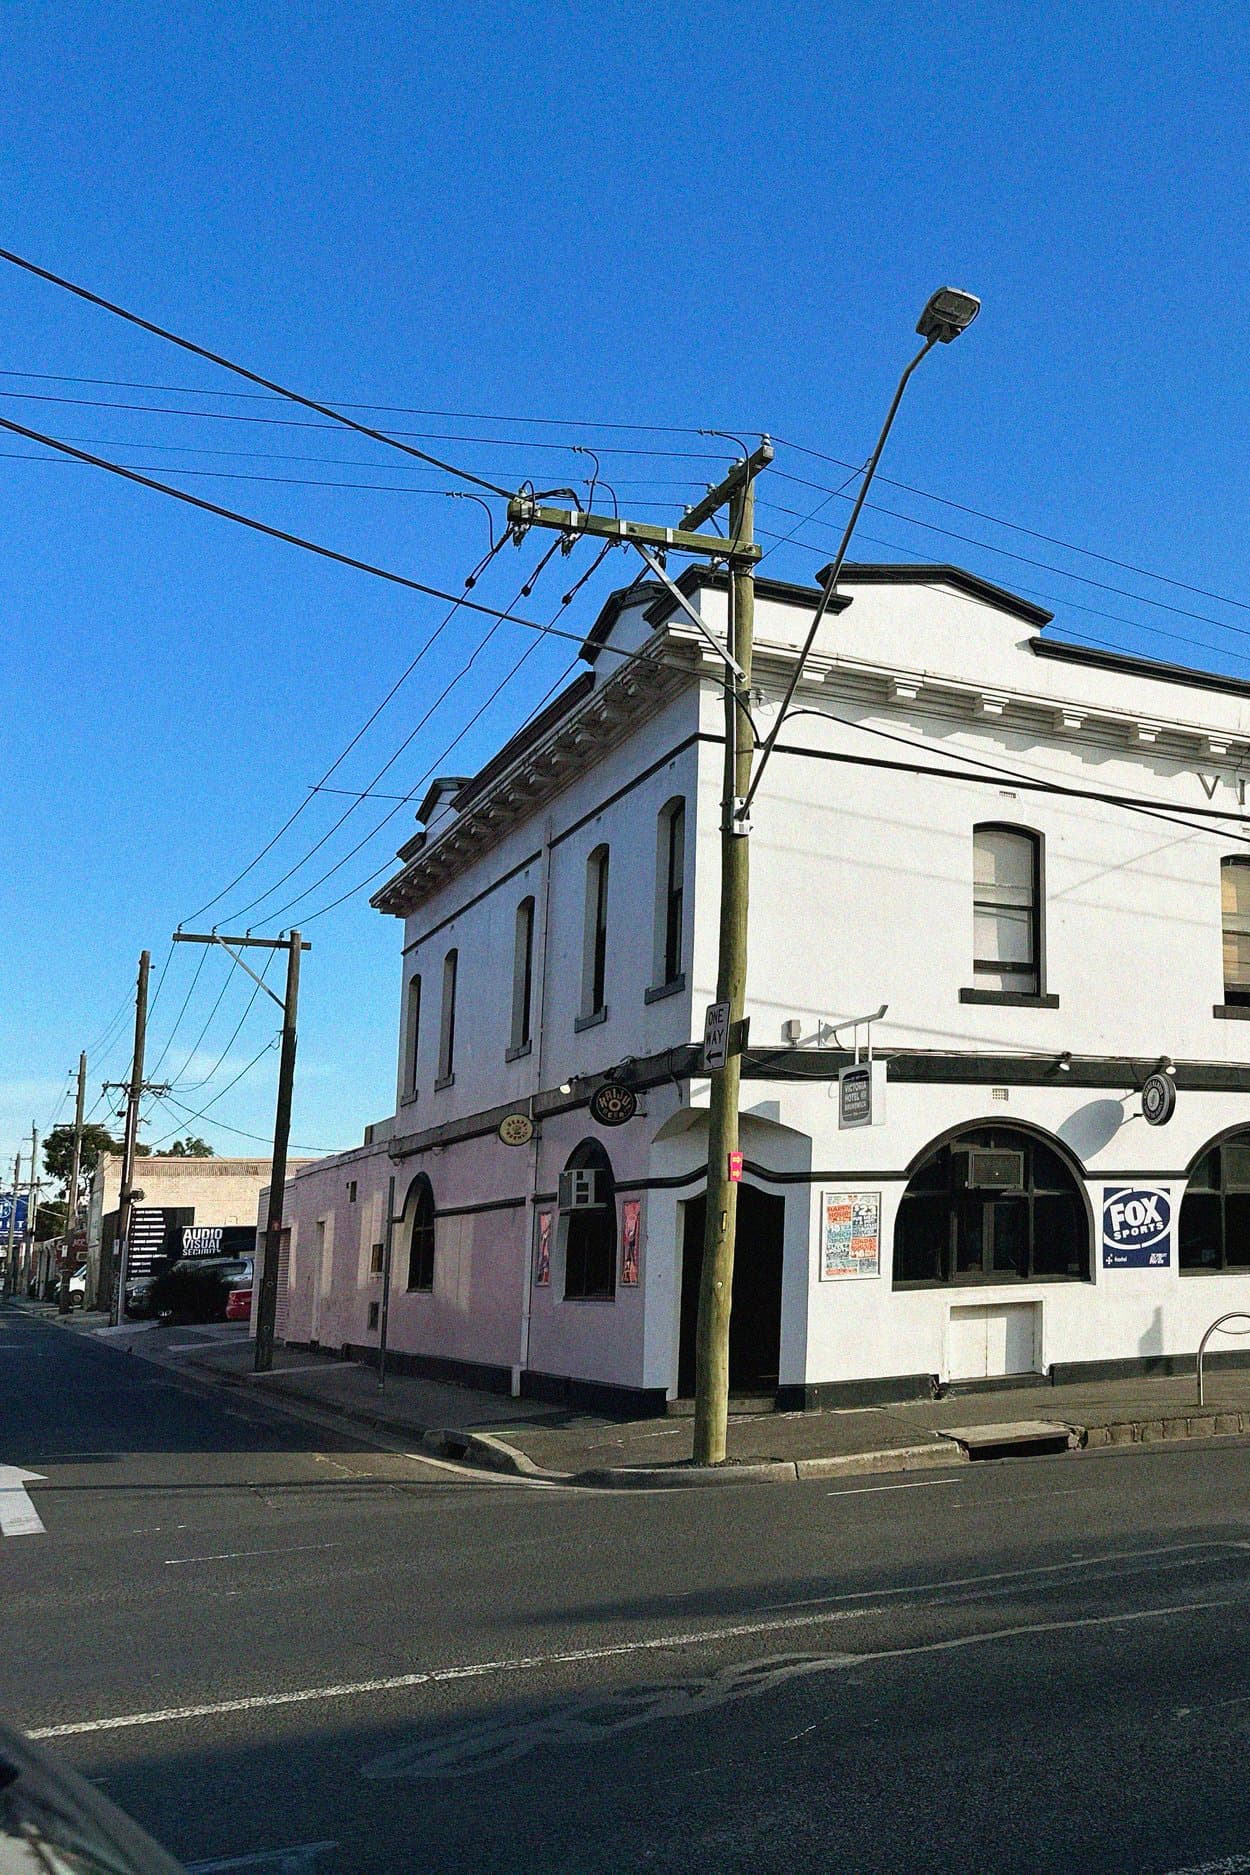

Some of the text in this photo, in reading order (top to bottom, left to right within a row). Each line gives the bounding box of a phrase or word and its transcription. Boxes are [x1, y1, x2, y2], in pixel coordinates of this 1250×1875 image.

[708, 1008, 724, 1026] ONE
[705, 1029, 724, 1046] WAY
[1110, 1196, 1163, 1232] FOX
[183, 1229, 223, 1240] AUDIO
[1113, 1221, 1164, 1240] SPORTS
